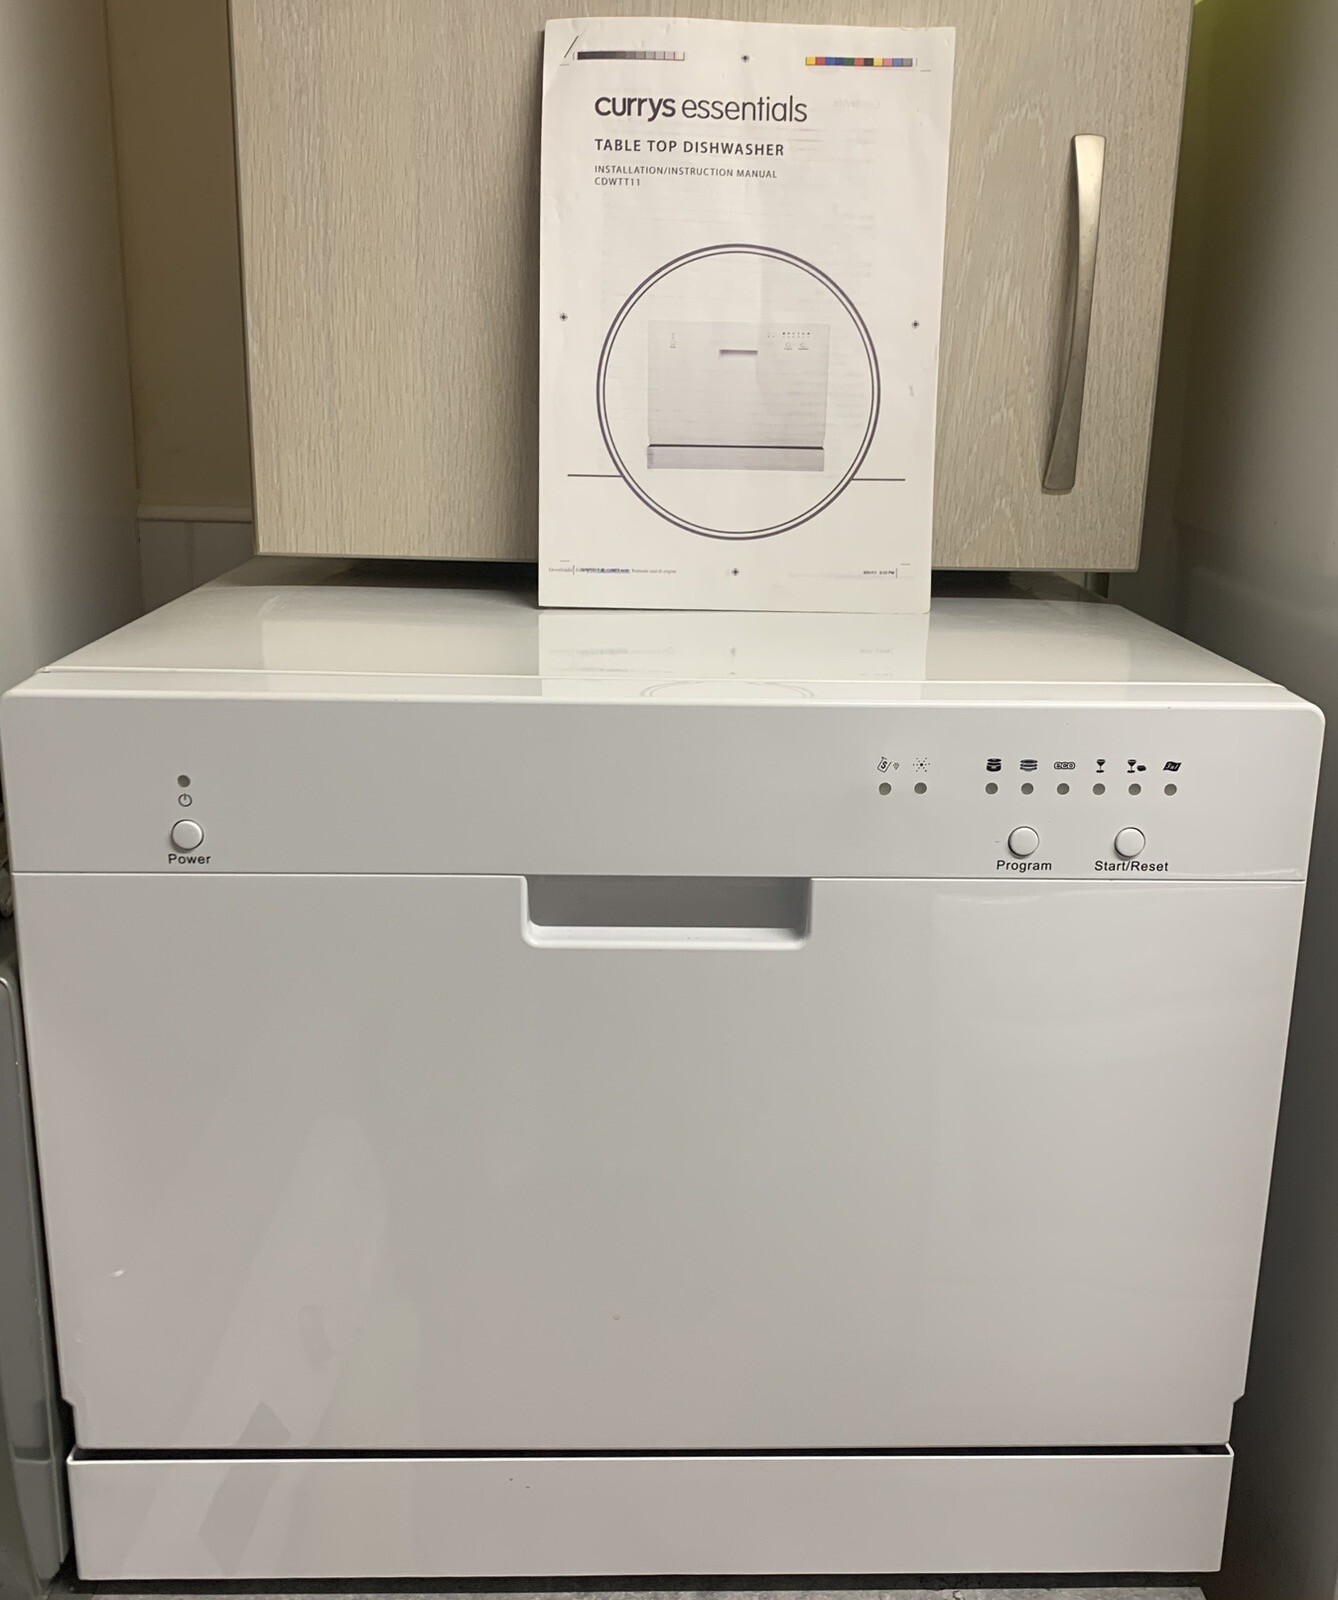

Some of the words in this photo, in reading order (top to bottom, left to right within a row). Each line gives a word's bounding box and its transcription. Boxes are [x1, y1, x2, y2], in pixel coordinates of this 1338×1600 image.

[594, 96, 676, 122] currys
[681, 94, 808, 122] essentials
[594, 138, 641, 152] TABLE
[646, 139, 677, 153] TOP
[683, 141, 785, 156] DISHWASHER
[594, 165, 733, 177] INSTALLATION/INSTRUCTION
[736, 169, 778, 179] MANUAL
[594, 177, 641, 186] CDWTT11
[168, 853, 211, 865] Power
[996, 860, 1052, 873] Program
[1094, 860, 1169, 872] Start/Reset
